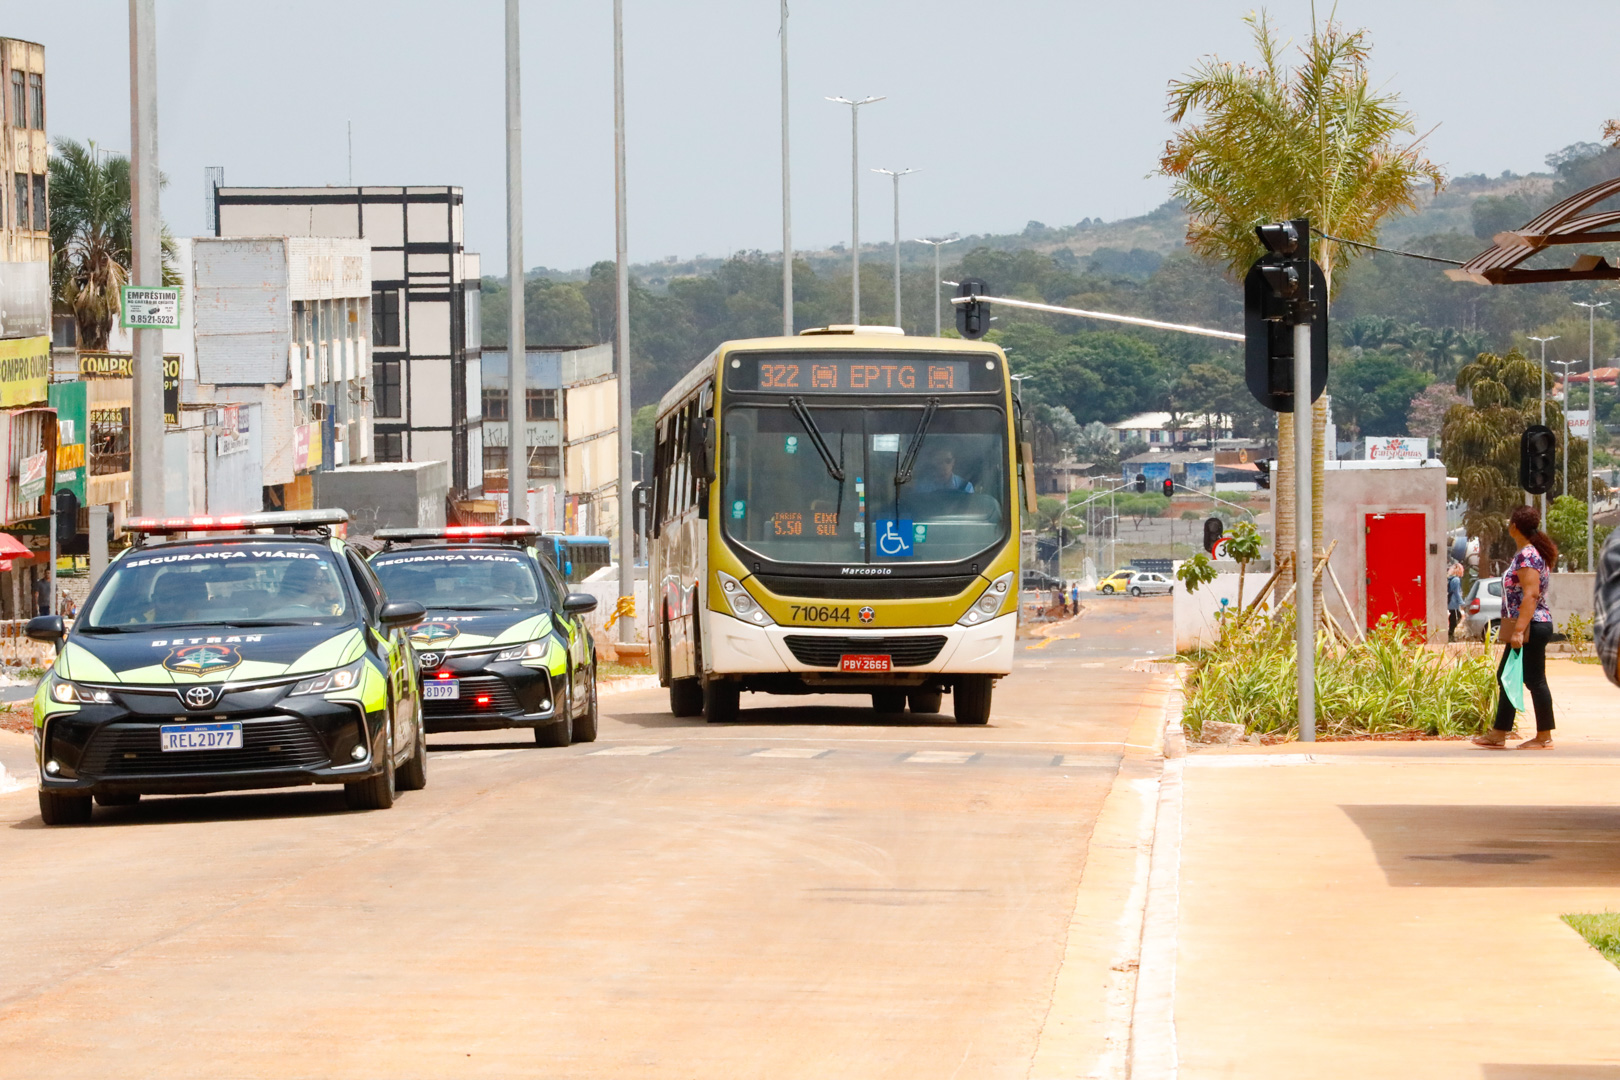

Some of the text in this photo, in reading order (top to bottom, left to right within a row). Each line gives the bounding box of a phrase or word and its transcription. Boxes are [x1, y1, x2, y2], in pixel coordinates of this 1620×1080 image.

[127, 291, 176, 300] EMPRÉSTIMO
[0, 354, 48, 382] OMPRO OURO
[761, 364, 915, 388] 322 EPTG
[775, 512, 802, 520] TARIFA
[774, 521, 802, 535] 5.50
[817, 524, 838, 536] SUL
[125, 550, 320, 569] SEGURANÇA VIÁRIA
[376, 554, 520, 567] SEGURANÇA VIÁRIA
[841, 567, 892, 576] Marcopolo
[790, 605, 851, 622] 710644
[151, 634, 263, 648] DETRAN
[426, 687, 453, 698] 8D99
[169, 732, 234, 748] REL2D77
